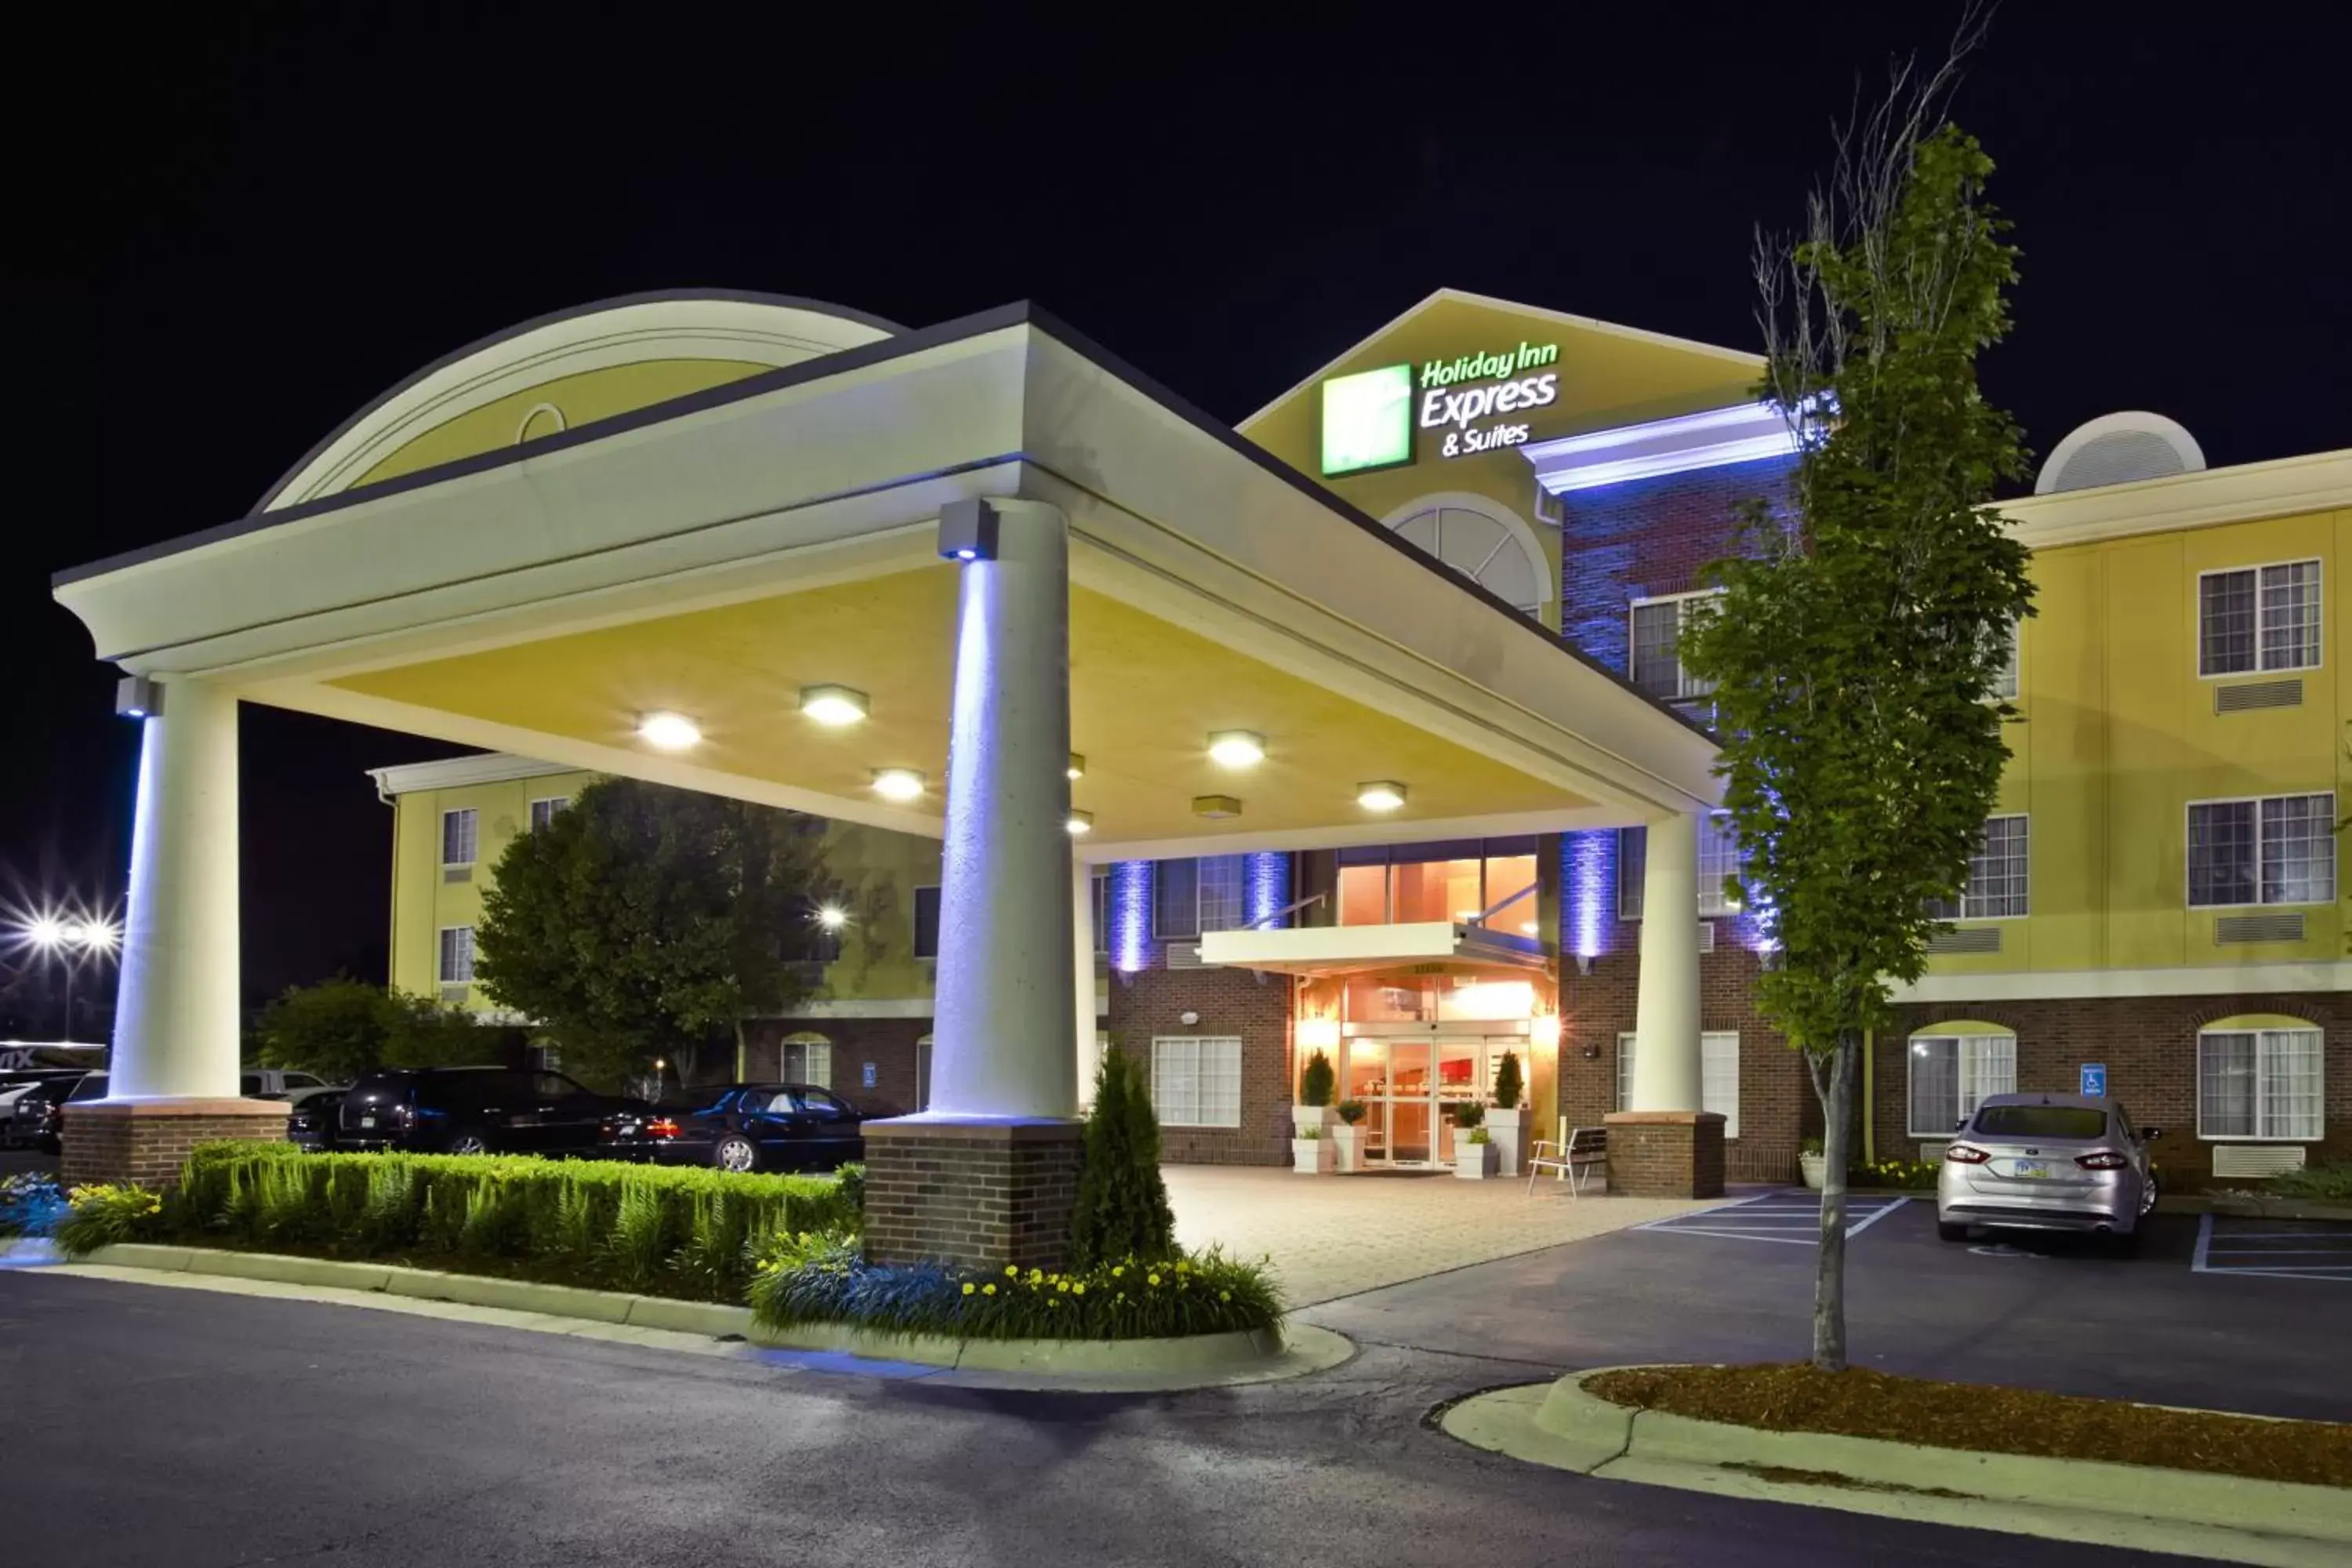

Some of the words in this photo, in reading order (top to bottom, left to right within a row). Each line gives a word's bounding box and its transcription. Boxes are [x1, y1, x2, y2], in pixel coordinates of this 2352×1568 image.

[1421, 351, 1515, 388] Holiday
[1517, 342, 1558, 369] Inn
[1421, 374, 1556, 429] Express
[1442, 433, 1459, 457] &
[1462, 423, 1528, 453] Suites
